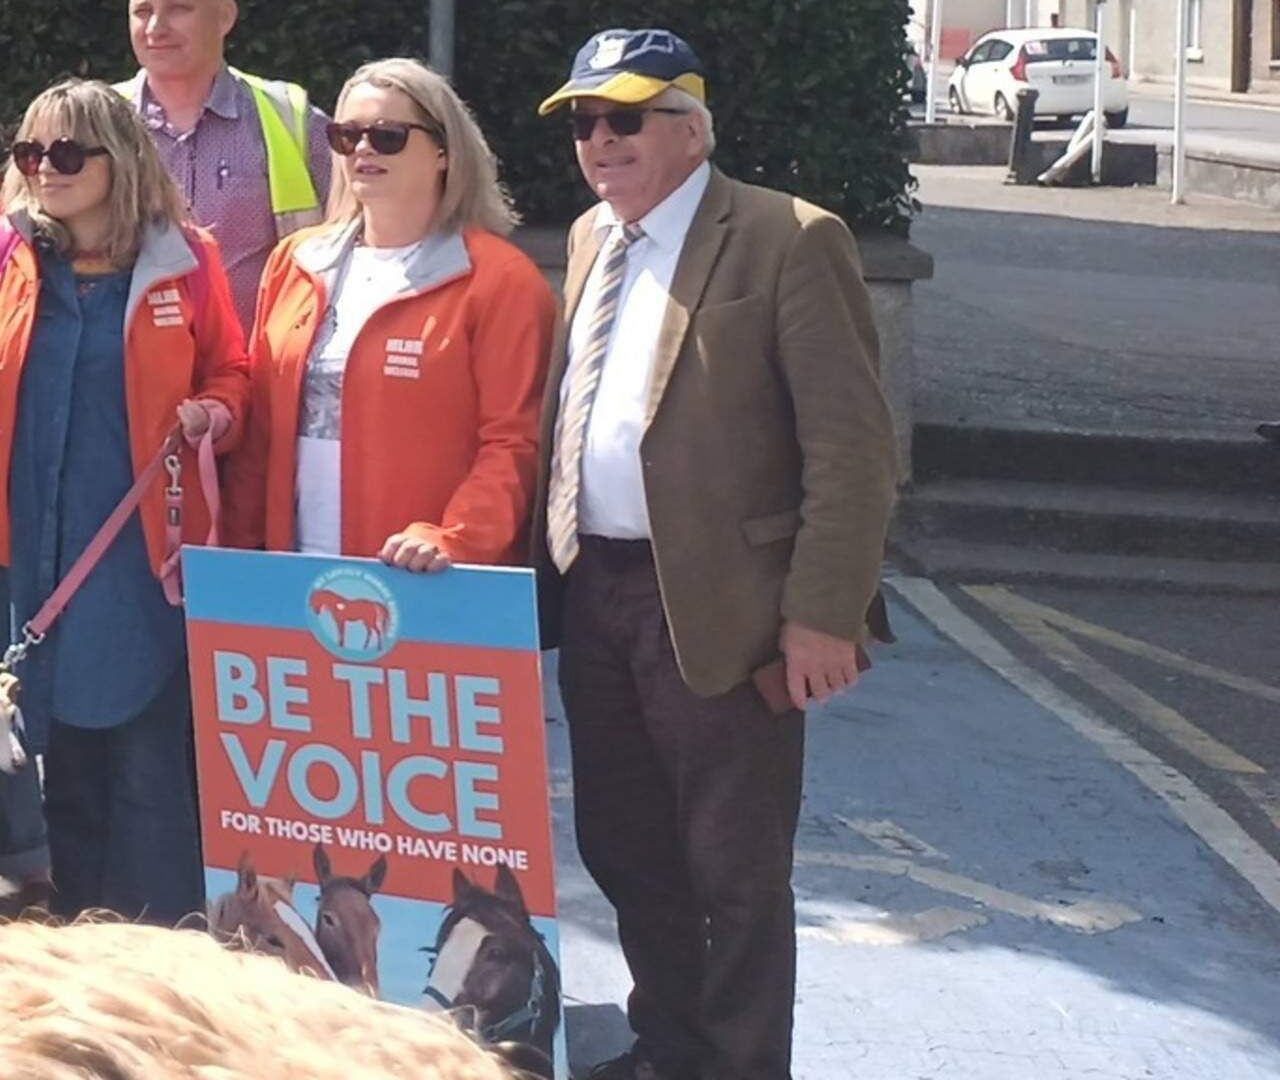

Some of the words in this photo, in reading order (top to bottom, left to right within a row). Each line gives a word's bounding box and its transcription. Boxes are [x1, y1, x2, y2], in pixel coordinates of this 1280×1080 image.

[213, 650, 312, 732] BE
[333, 663, 504, 753] THE
[219, 732, 503, 839] VOICE
[220, 810, 261, 835] FOR
[265, 816, 333, 844] THOSE
[335, 826, 392, 853] WHO
[396, 835, 458, 863] HAVE
[462, 844, 529, 870] NONE
